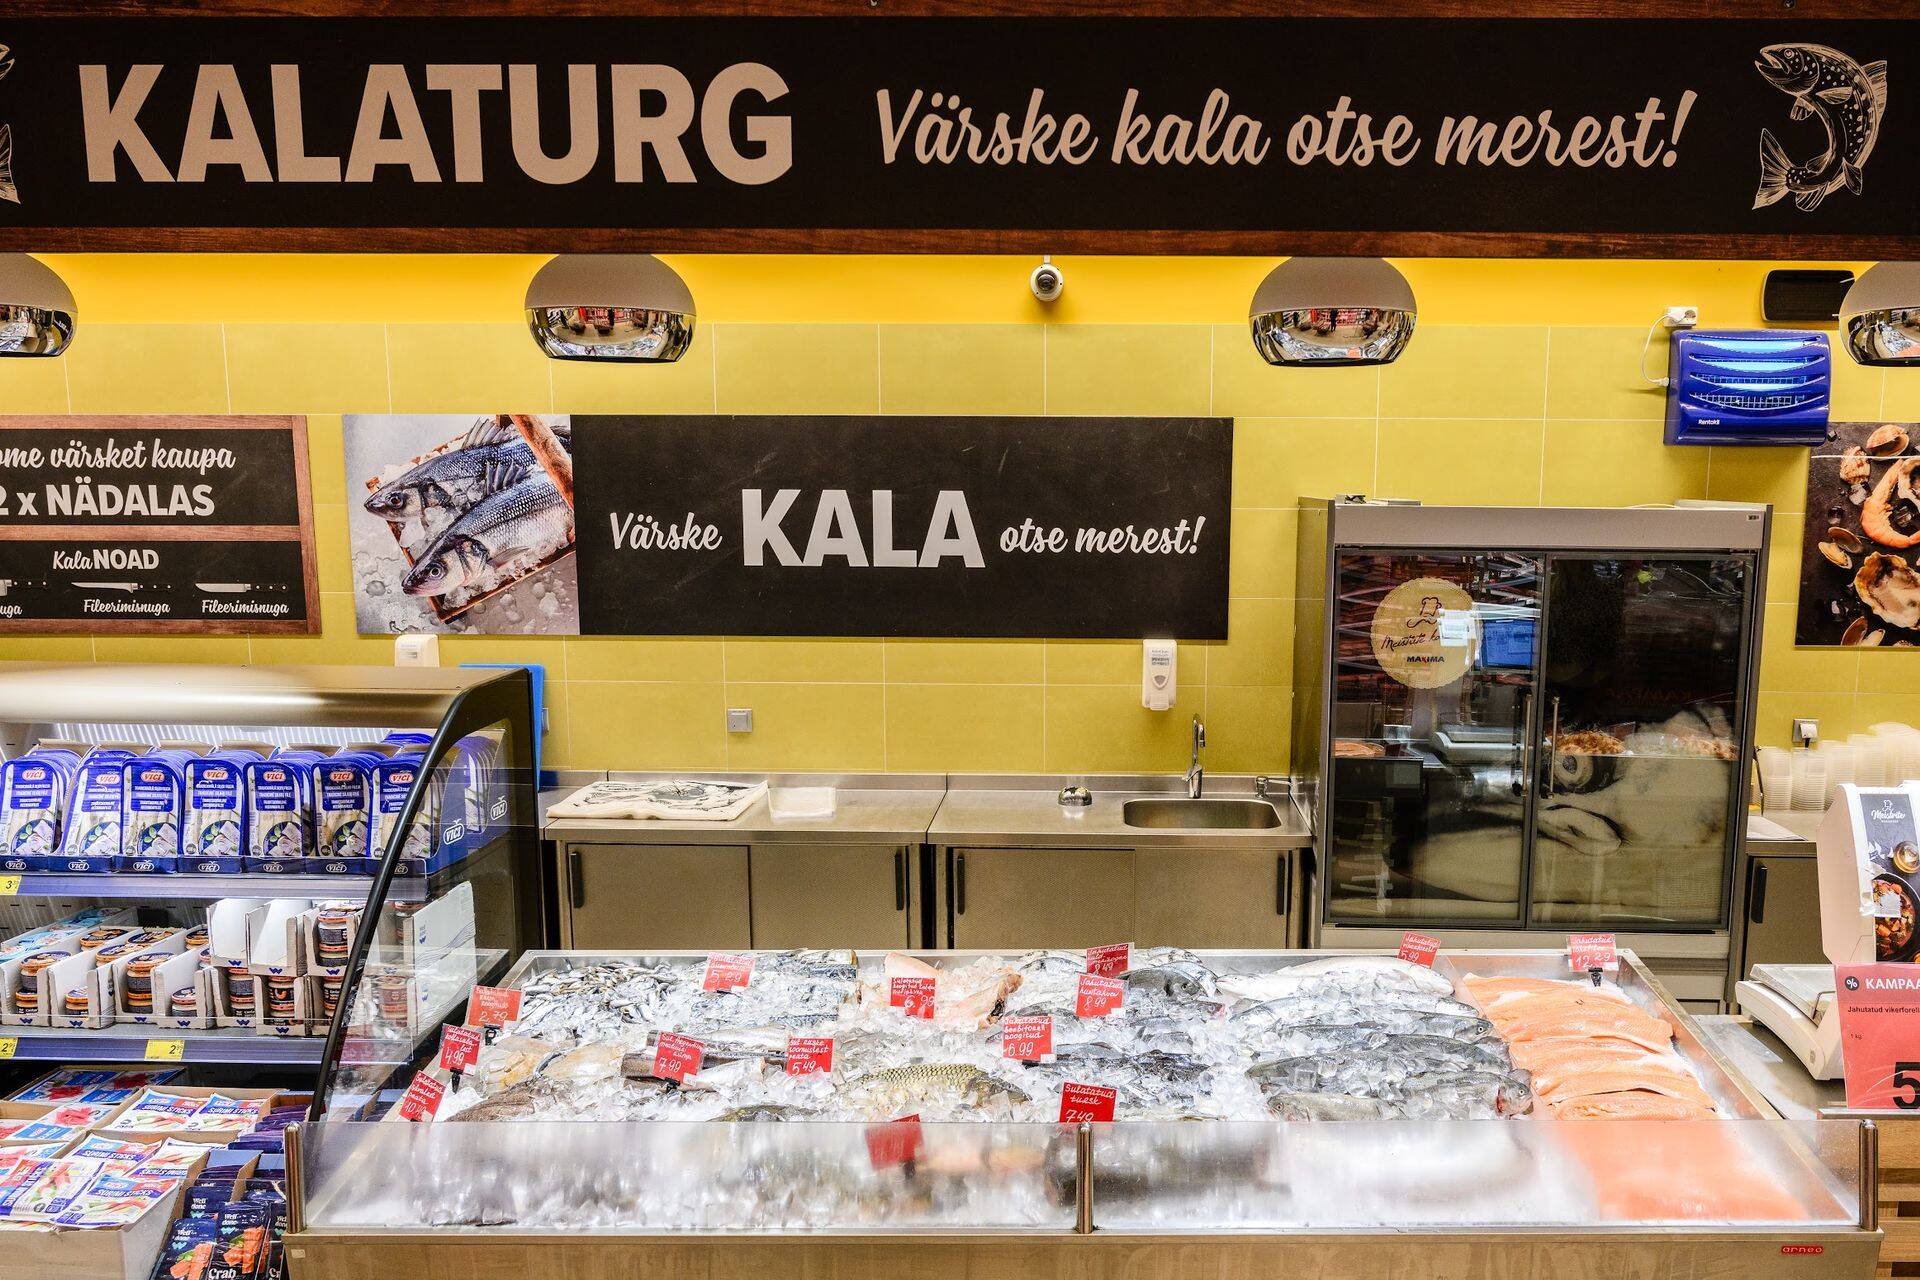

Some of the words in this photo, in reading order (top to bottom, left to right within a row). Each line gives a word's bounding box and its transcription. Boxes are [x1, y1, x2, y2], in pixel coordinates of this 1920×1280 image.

[79, 63, 792, 184] KALATURG
[877, 88, 1098, 165] Värske
[1112, 88, 1271, 165] kala
[1287, 96, 1421, 166] otse
[1435, 90, 1697, 167] merest!
[50, 438, 147, 469] värsket
[152, 438, 236, 476] kaupa
[17, 493, 38, 515] x
[46, 475, 216, 517] NÄDALAS
[610, 511, 722, 551] Värske
[742, 489, 985, 568] KALA
[1000, 518, 1068, 554] otse
[1075, 516, 1206, 555] merest!
[83, 598, 171, 618] Fileerimisnuga
[201, 598, 290, 618] Fileerimisnuga
[26, 771, 43, 779] VICI
[145, 773, 162, 781] VICI
[206, 771, 225, 779] VICI
[333, 772, 350, 780] VICI
[392, 773, 410, 781] VICI
[493, 802, 506, 818] VICI
[445, 825, 461, 843] VICI
[136, 862, 151, 870] VICI
[1080, 977, 1124, 989] Jahutatud
[1848, 1005, 1883, 1013] Jahutatud
[1065, 1084, 1115, 1099] Sulatatud
[1892, 1061, 1920, 1110] 5
[1070, 1095, 1102, 1106] tursk
[142, 1104, 166, 1112] SURIMI
[167, 1106, 193, 1115] STICKS
[208, 1107, 233, 1115] SURIMI
[233, 1107, 259, 1115] STICKS
[83, 1149, 109, 1159] SURIMI
[110, 1152, 136, 1160] STICKS
[96, 1188, 125, 1198] SURIMI
[125, 1189, 153, 1198] STICKS
[208, 1267, 237, 1280] Crab
[268, 1267, 281, 1280] Cr
